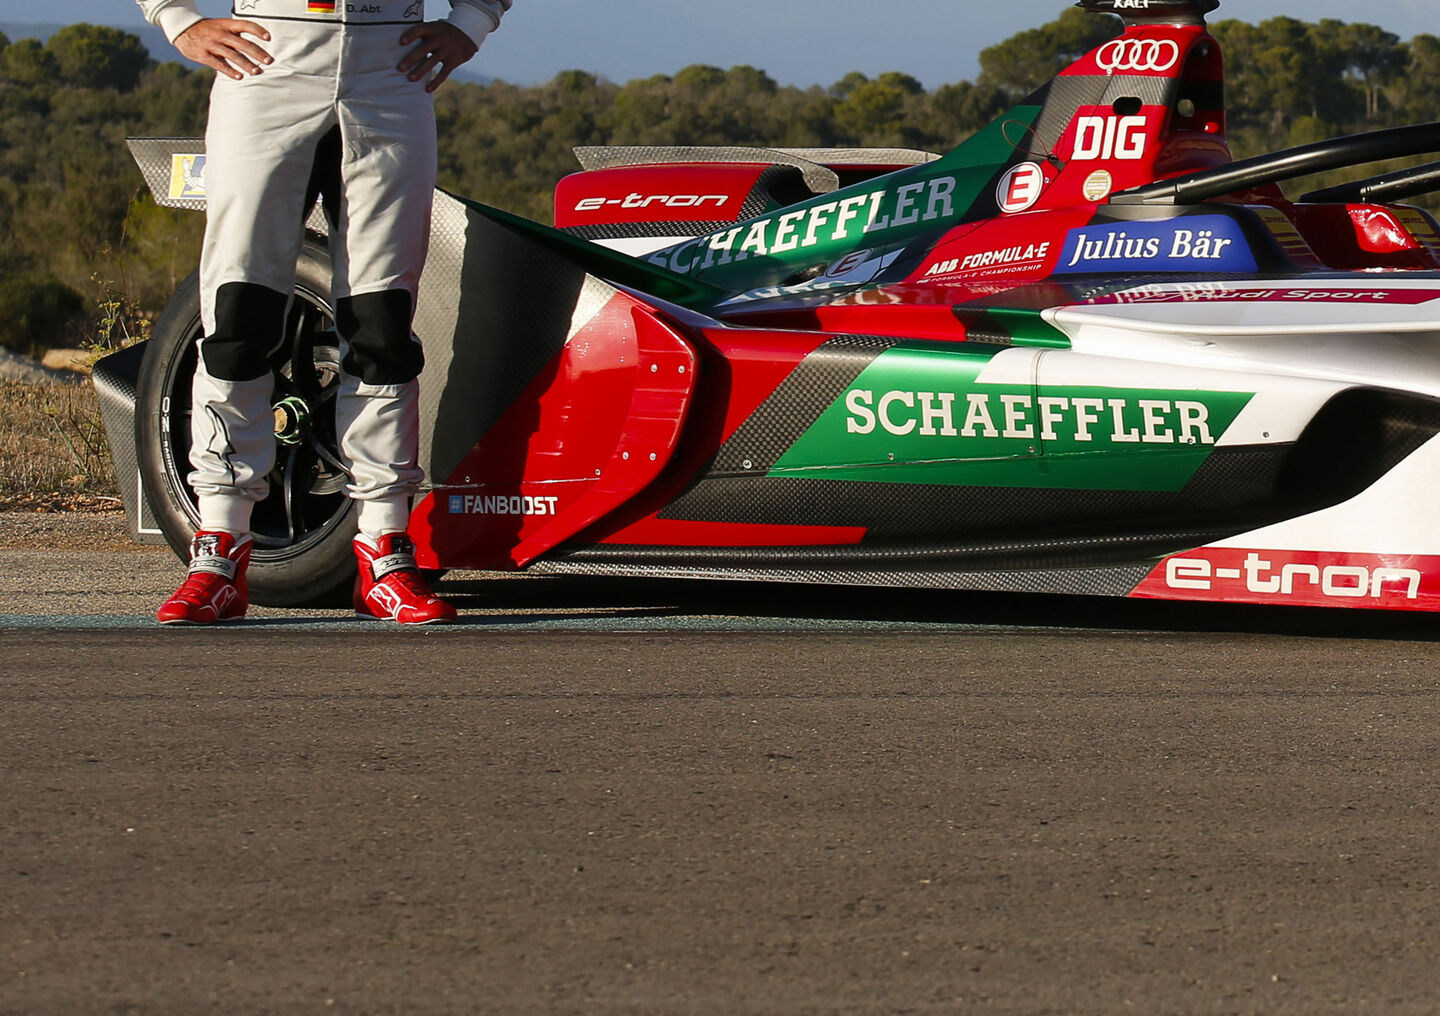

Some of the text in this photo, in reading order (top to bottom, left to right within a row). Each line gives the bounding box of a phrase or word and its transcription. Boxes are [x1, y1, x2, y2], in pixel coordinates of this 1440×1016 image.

[360, 4, 381, 14] Abt
[1070, 115, 1148, 161] DIG
[573, 192, 729, 212] e-tron
[1068, 229, 1232, 267] Julius Bär
[923, 258, 960, 277] ABB
[979, 263, 1042, 277] CHAMPIONSHIP
[1282, 289, 1390, 300] Sport
[845, 389, 1215, 444] SCHAEFFLER
[1165, 552, 1422, 600] e-tron
